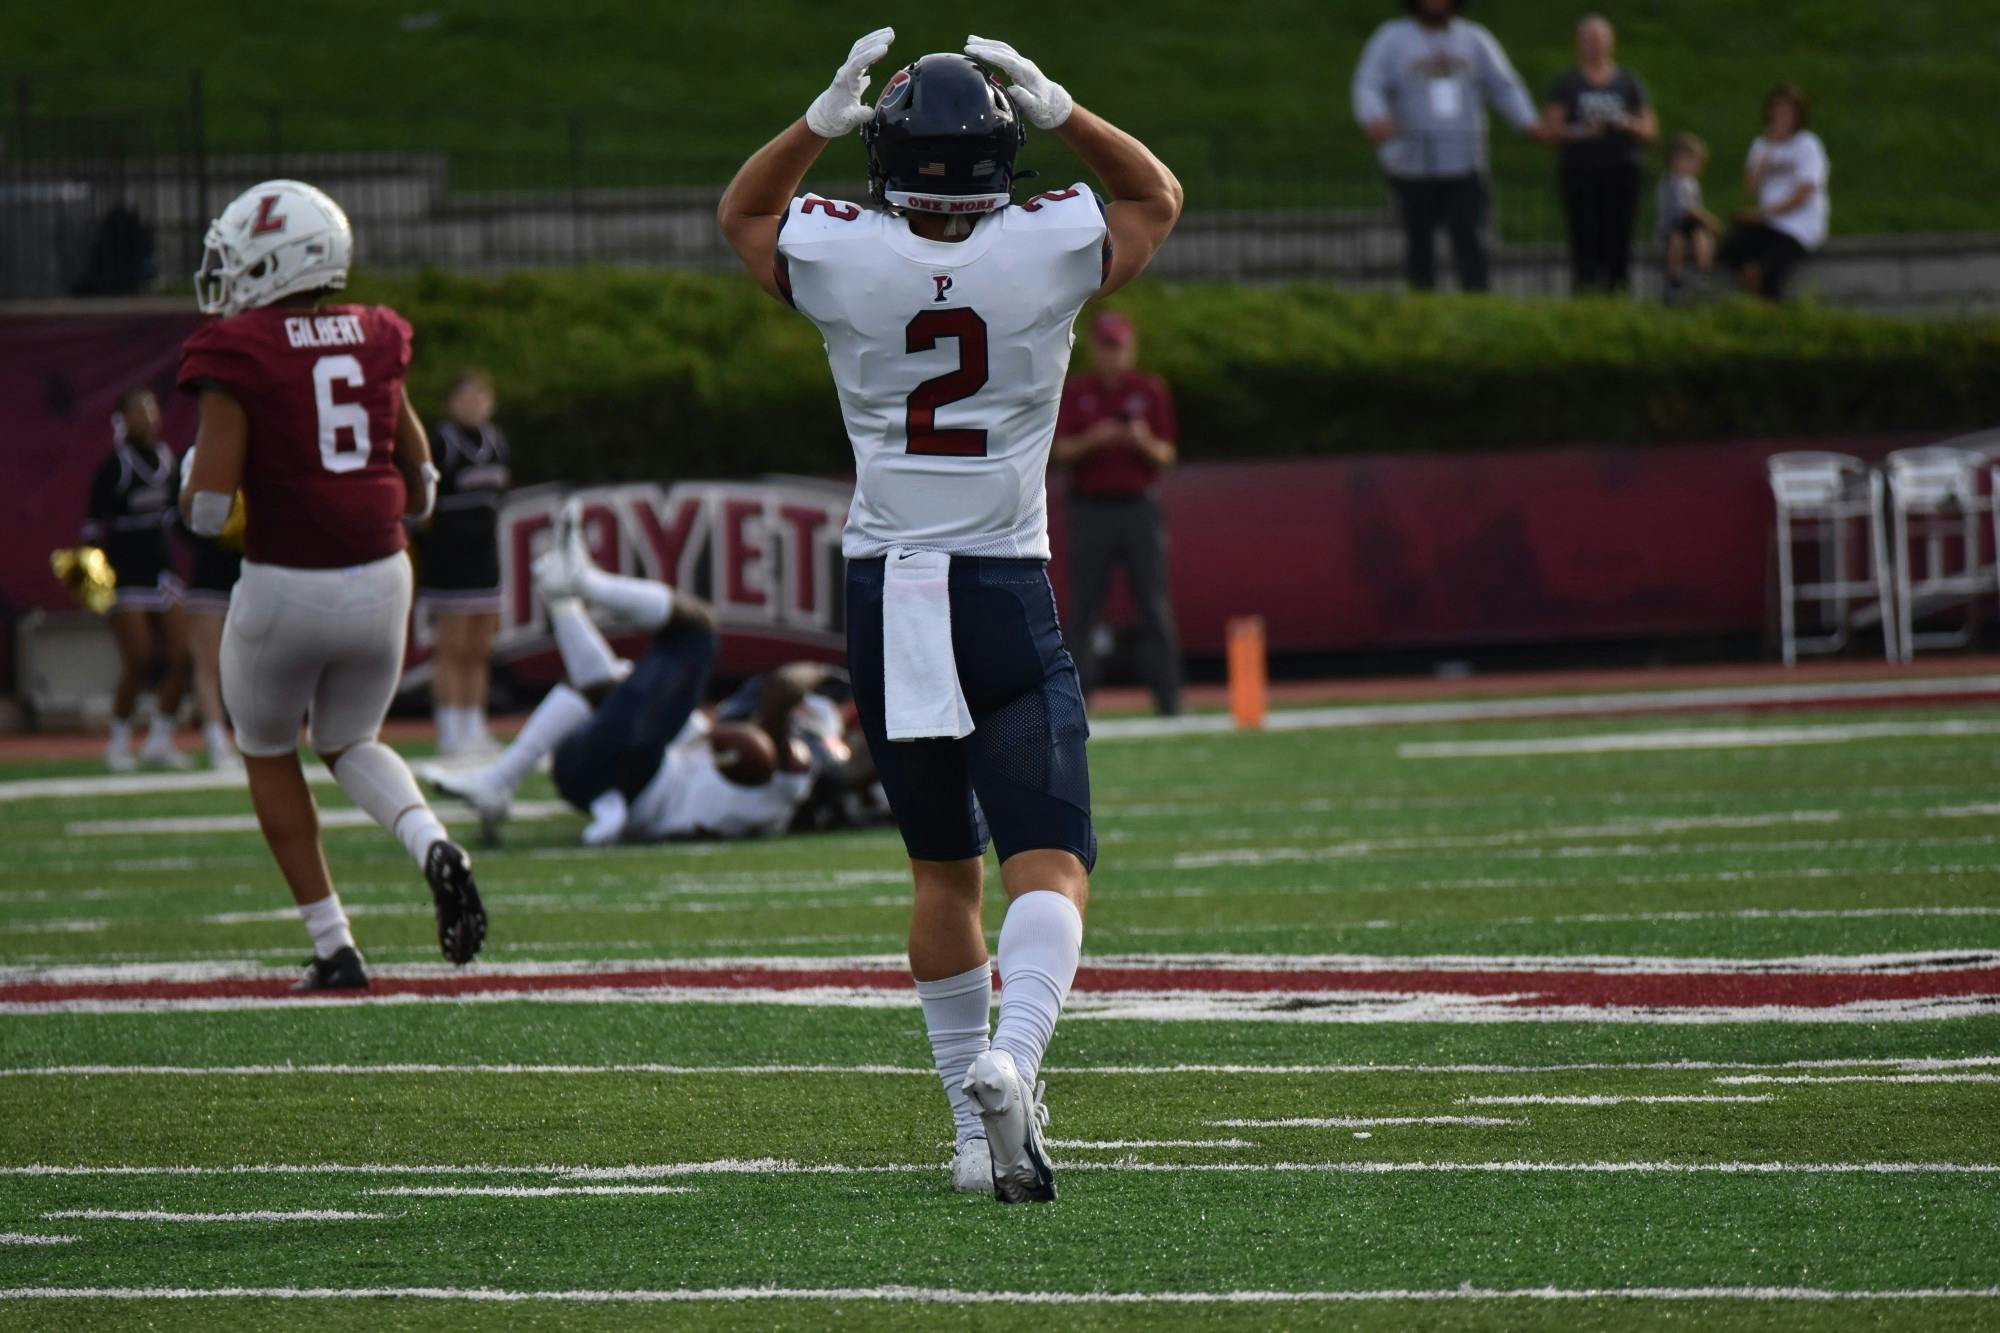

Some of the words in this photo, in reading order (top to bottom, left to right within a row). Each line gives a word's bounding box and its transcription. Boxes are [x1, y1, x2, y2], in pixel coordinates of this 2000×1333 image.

[251, 194, 287, 237] L
[801, 198, 860, 221] 2
[908, 196, 943, 210] ONE
[950, 198, 997, 212] MORE
[933, 275, 953, 301] P
[285, 315, 365, 348] GILBERT
[905, 306, 988, 457] 2
[312, 354, 371, 473] 6
